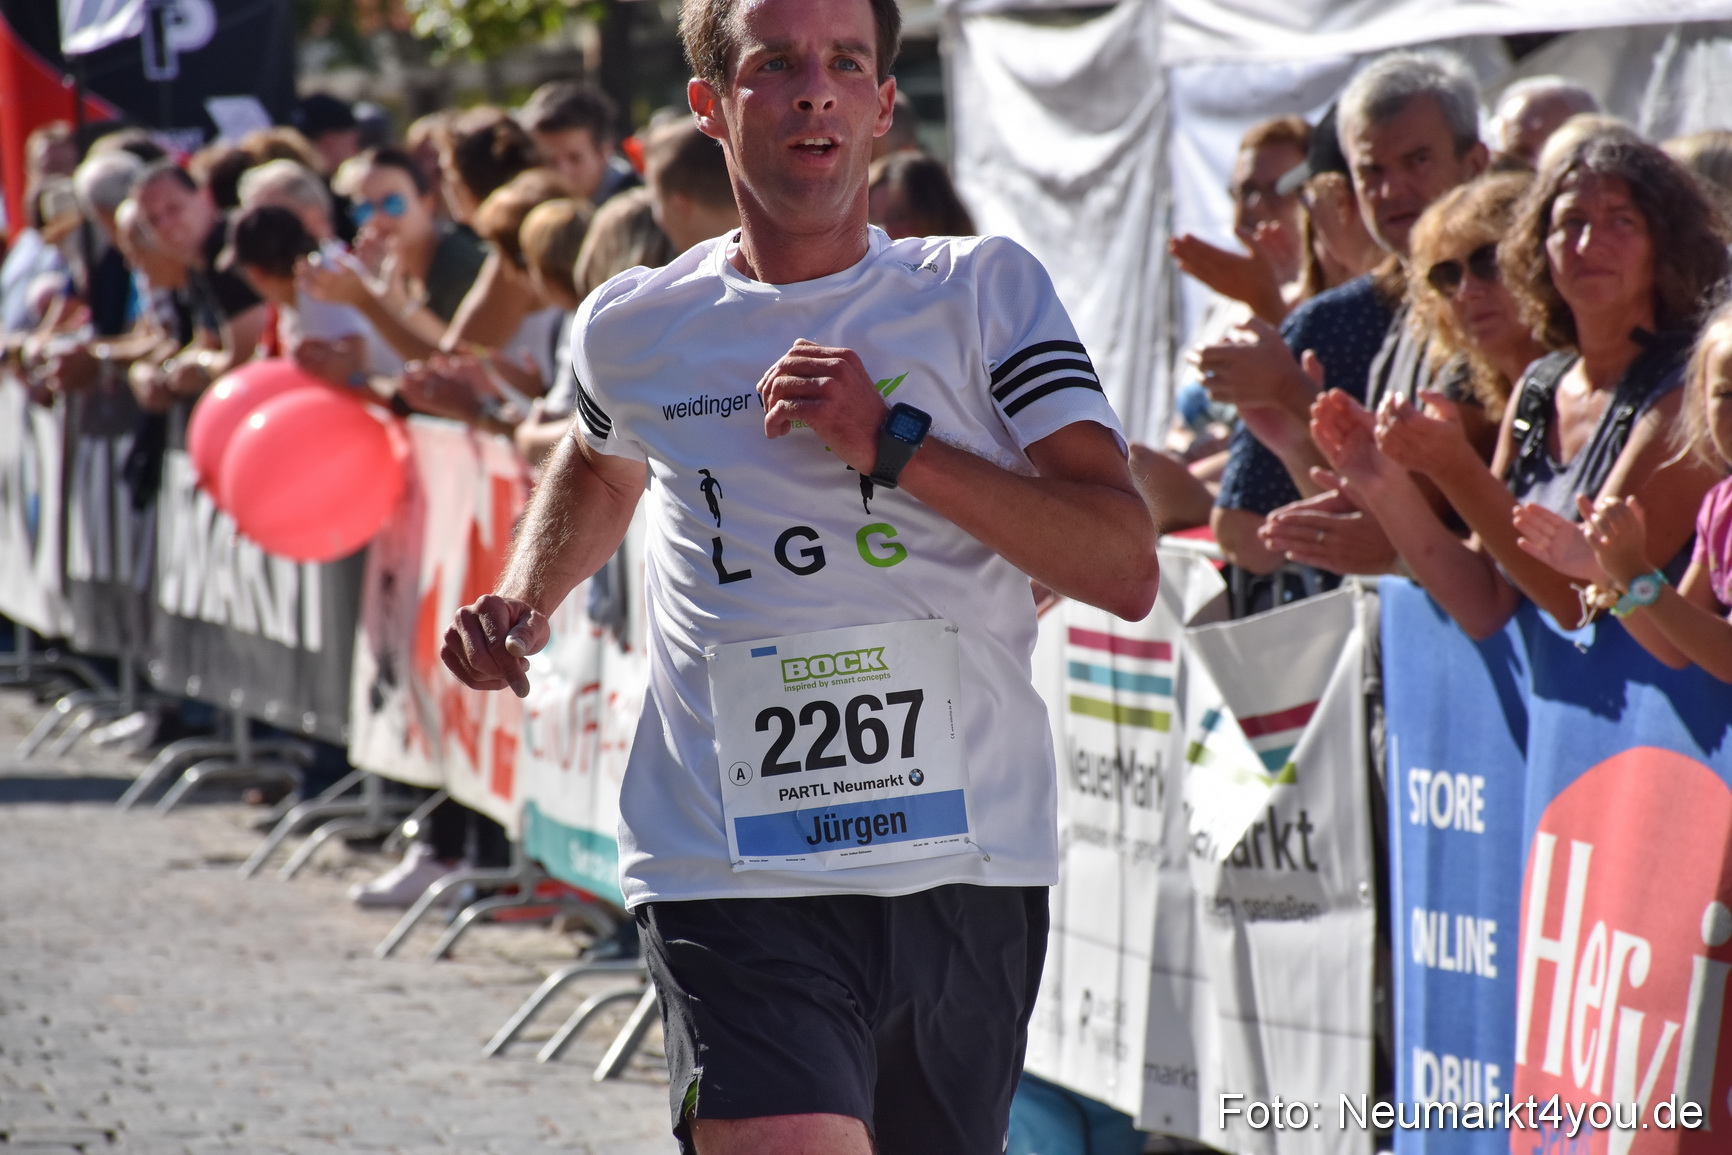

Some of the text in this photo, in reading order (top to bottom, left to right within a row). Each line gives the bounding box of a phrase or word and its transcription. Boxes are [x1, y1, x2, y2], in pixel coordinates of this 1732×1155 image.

[662, 392, 752, 421] weidinger
[781, 647, 889, 682] BOCK
[784, 671, 891, 692] inspired by smart concepts
[755, 688, 924, 778] 2267
[735, 767, 746, 781] A
[778, 775, 904, 802] PARTL Neumarkt
[1408, 767, 1485, 834] STORE
[806, 810, 907, 846] Jürgen
[1411, 906, 1498, 979] ONLINE
